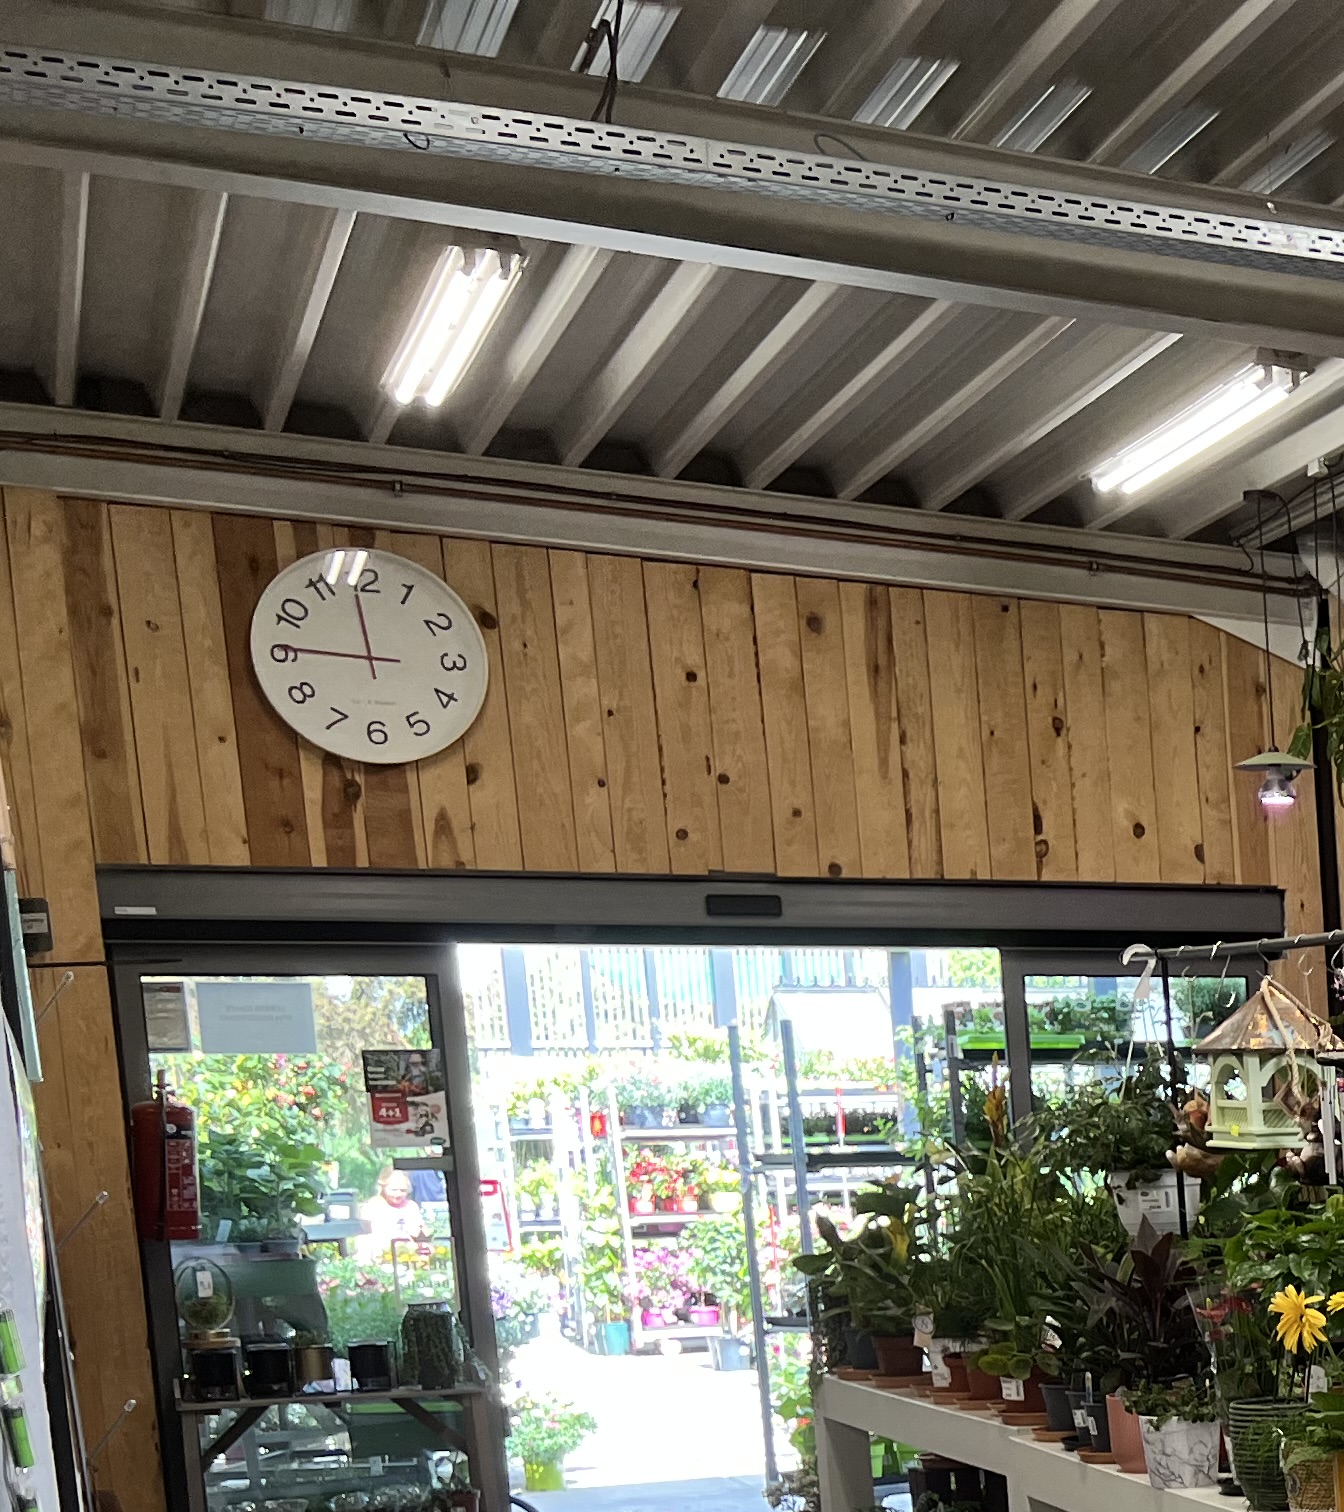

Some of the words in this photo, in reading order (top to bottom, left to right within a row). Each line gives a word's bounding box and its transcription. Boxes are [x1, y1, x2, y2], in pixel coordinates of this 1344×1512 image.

[305, 572, 336, 601] 11
[400, 583, 415, 605] 1
[275, 598, 309, 629] 10
[423, 612, 453, 636] 2
[270, 643, 298, 663] 9
[440, 652, 467, 671] 3
[287, 681, 316, 704] 8
[434, 687, 458, 709] 4
[326, 706, 349, 730] 7
[405, 711, 431, 737] 5
[366, 720, 389, 745] 6
